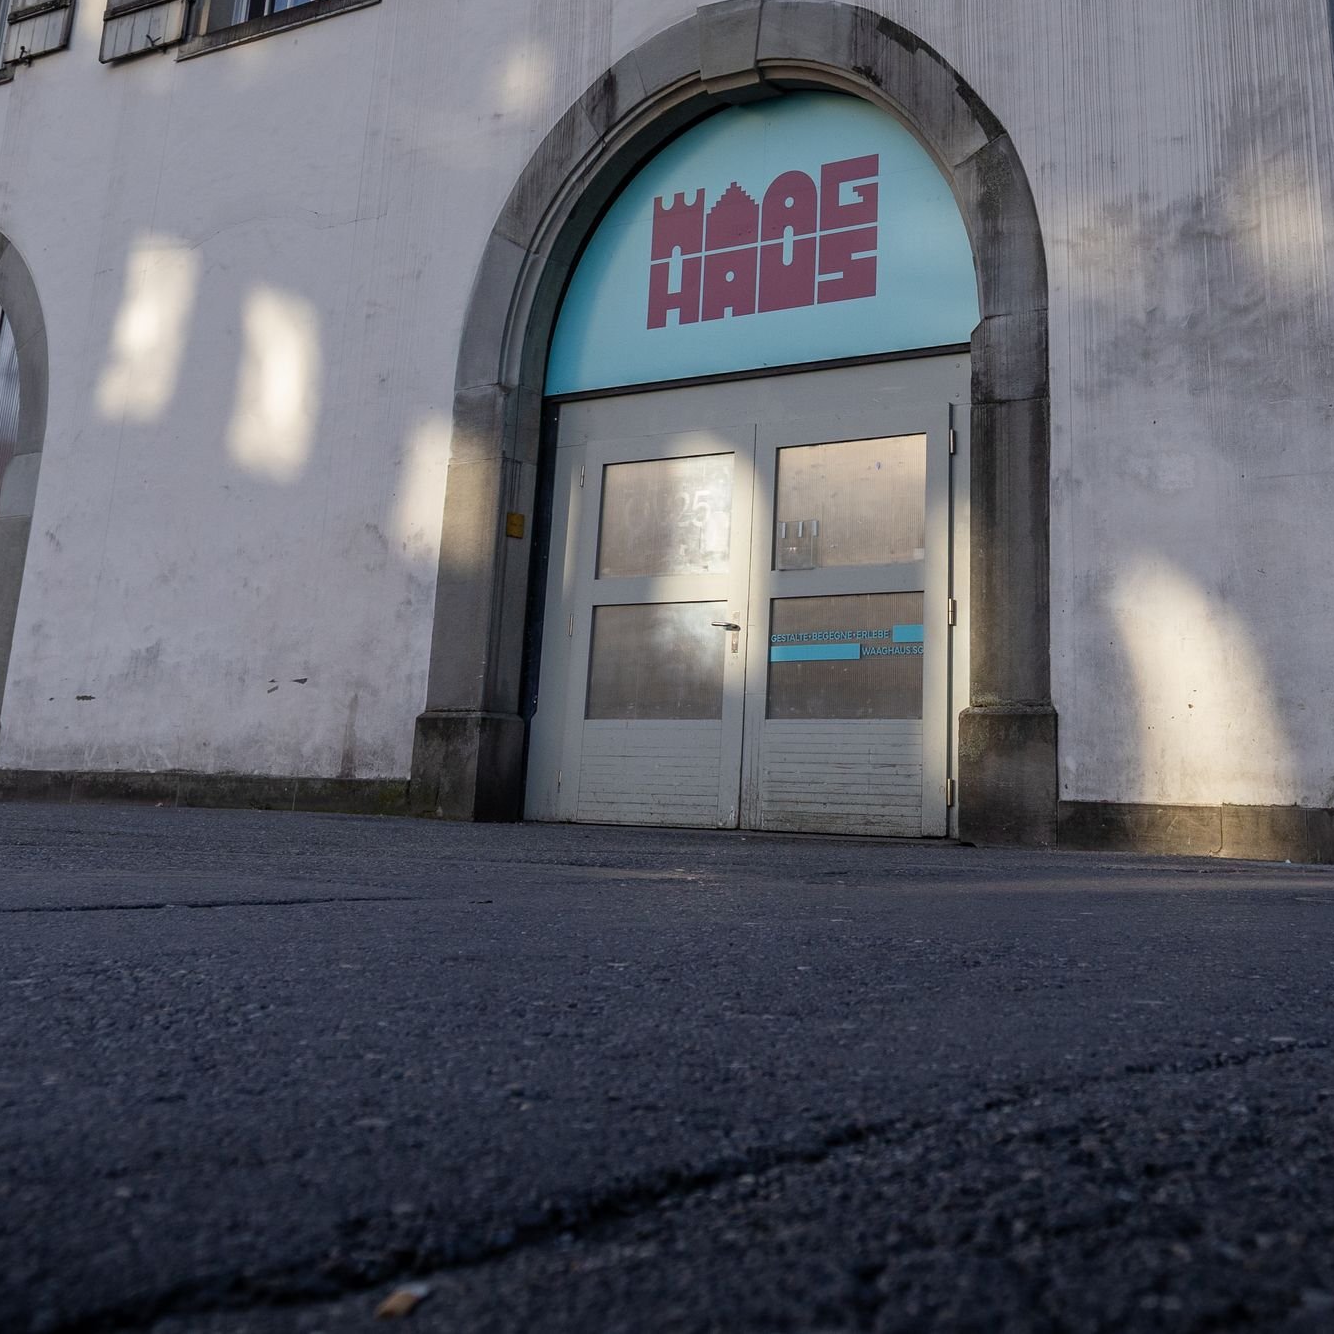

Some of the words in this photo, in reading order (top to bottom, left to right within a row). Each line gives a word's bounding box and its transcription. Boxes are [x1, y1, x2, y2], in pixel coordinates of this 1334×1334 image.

[651, 153, 879, 262] WAAG
[646, 225, 878, 330] HAUS
[861, 645, 924, 656] WAAGHAUS.SG
